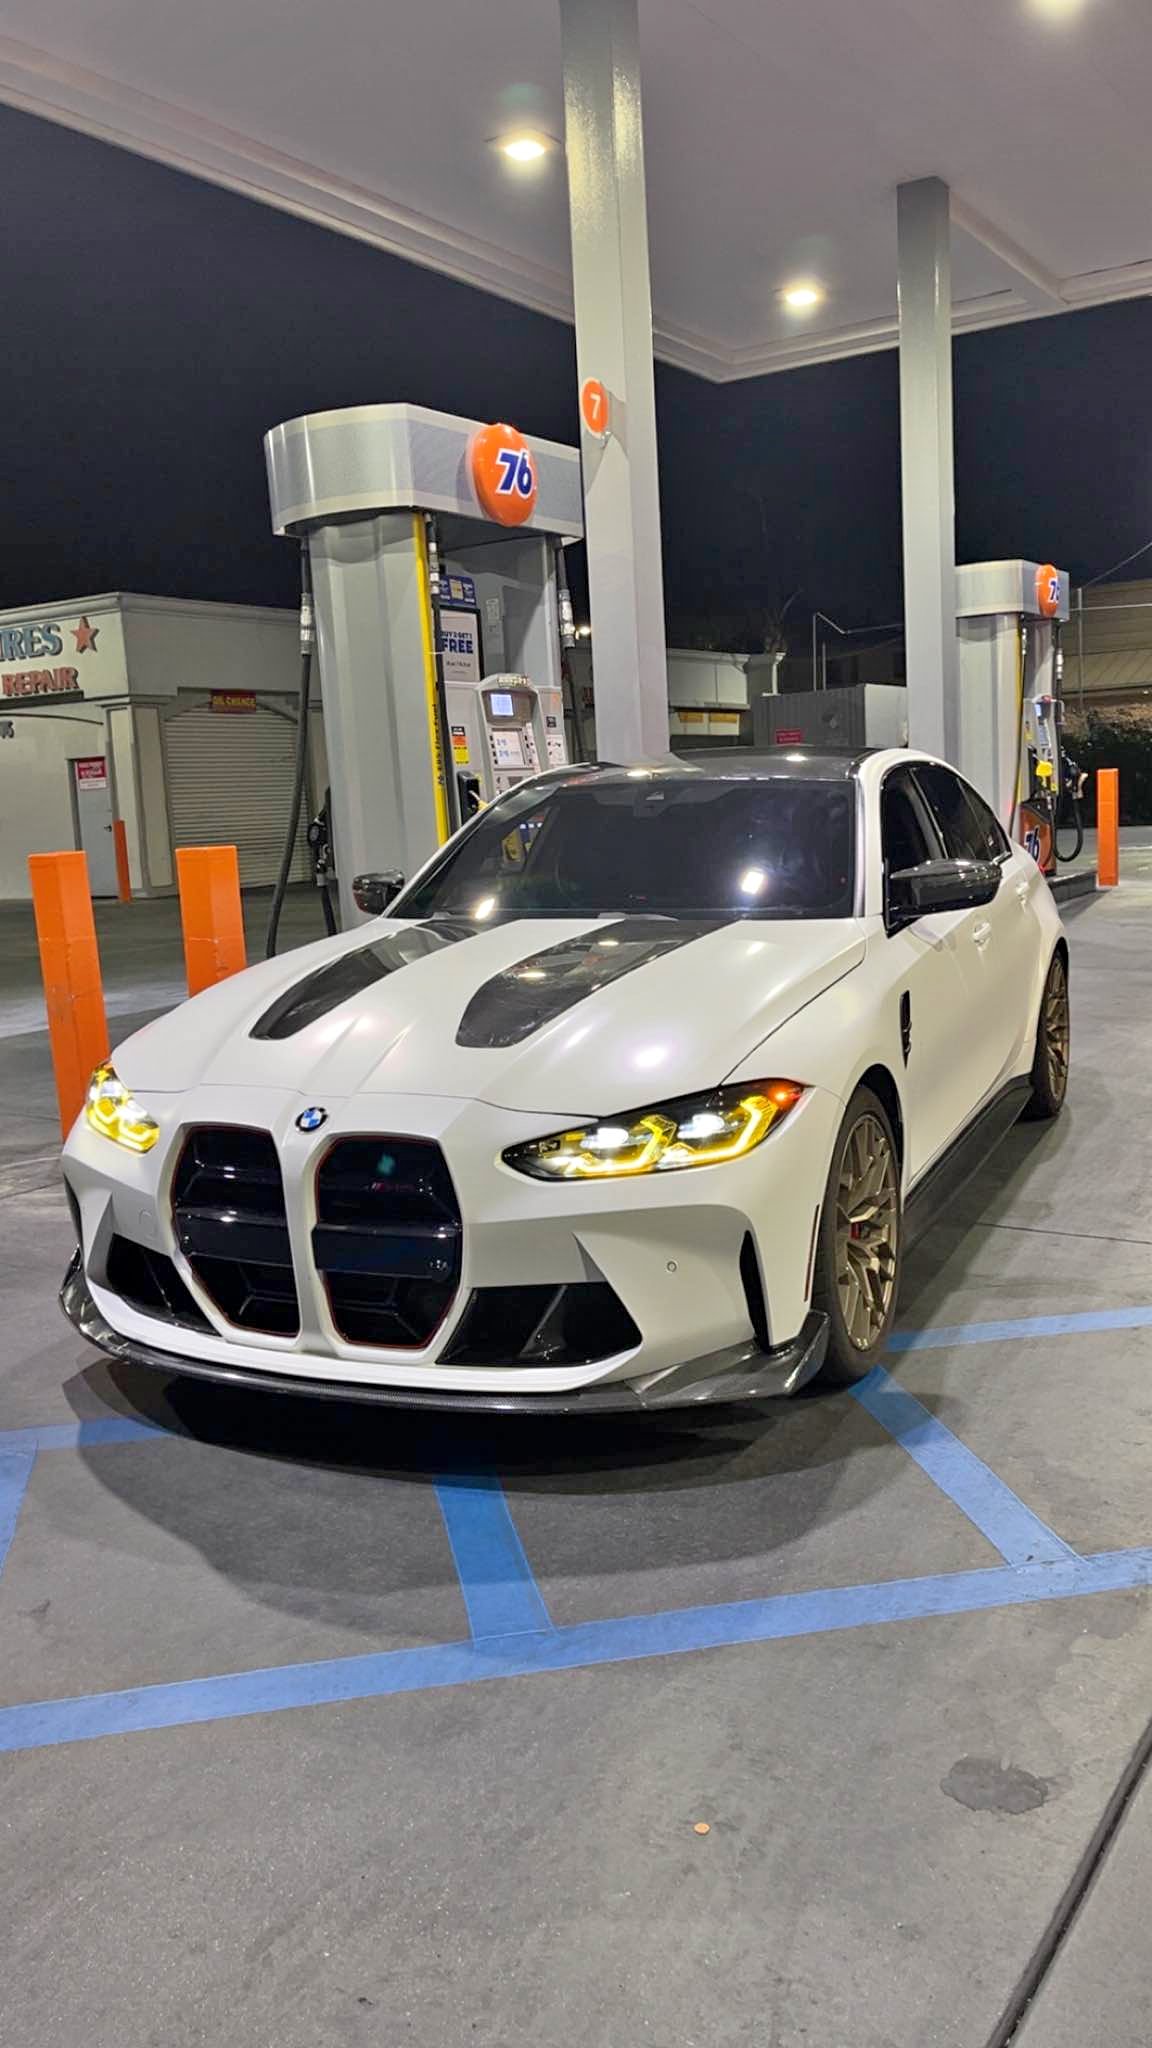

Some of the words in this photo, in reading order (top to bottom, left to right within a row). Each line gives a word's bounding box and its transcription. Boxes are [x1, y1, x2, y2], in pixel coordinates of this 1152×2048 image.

[590, 393, 601, 420] 7
[495, 448, 533, 499] 76
[441, 638, 474, 654] FREE
[1, 667, 79, 697] REPAIR
